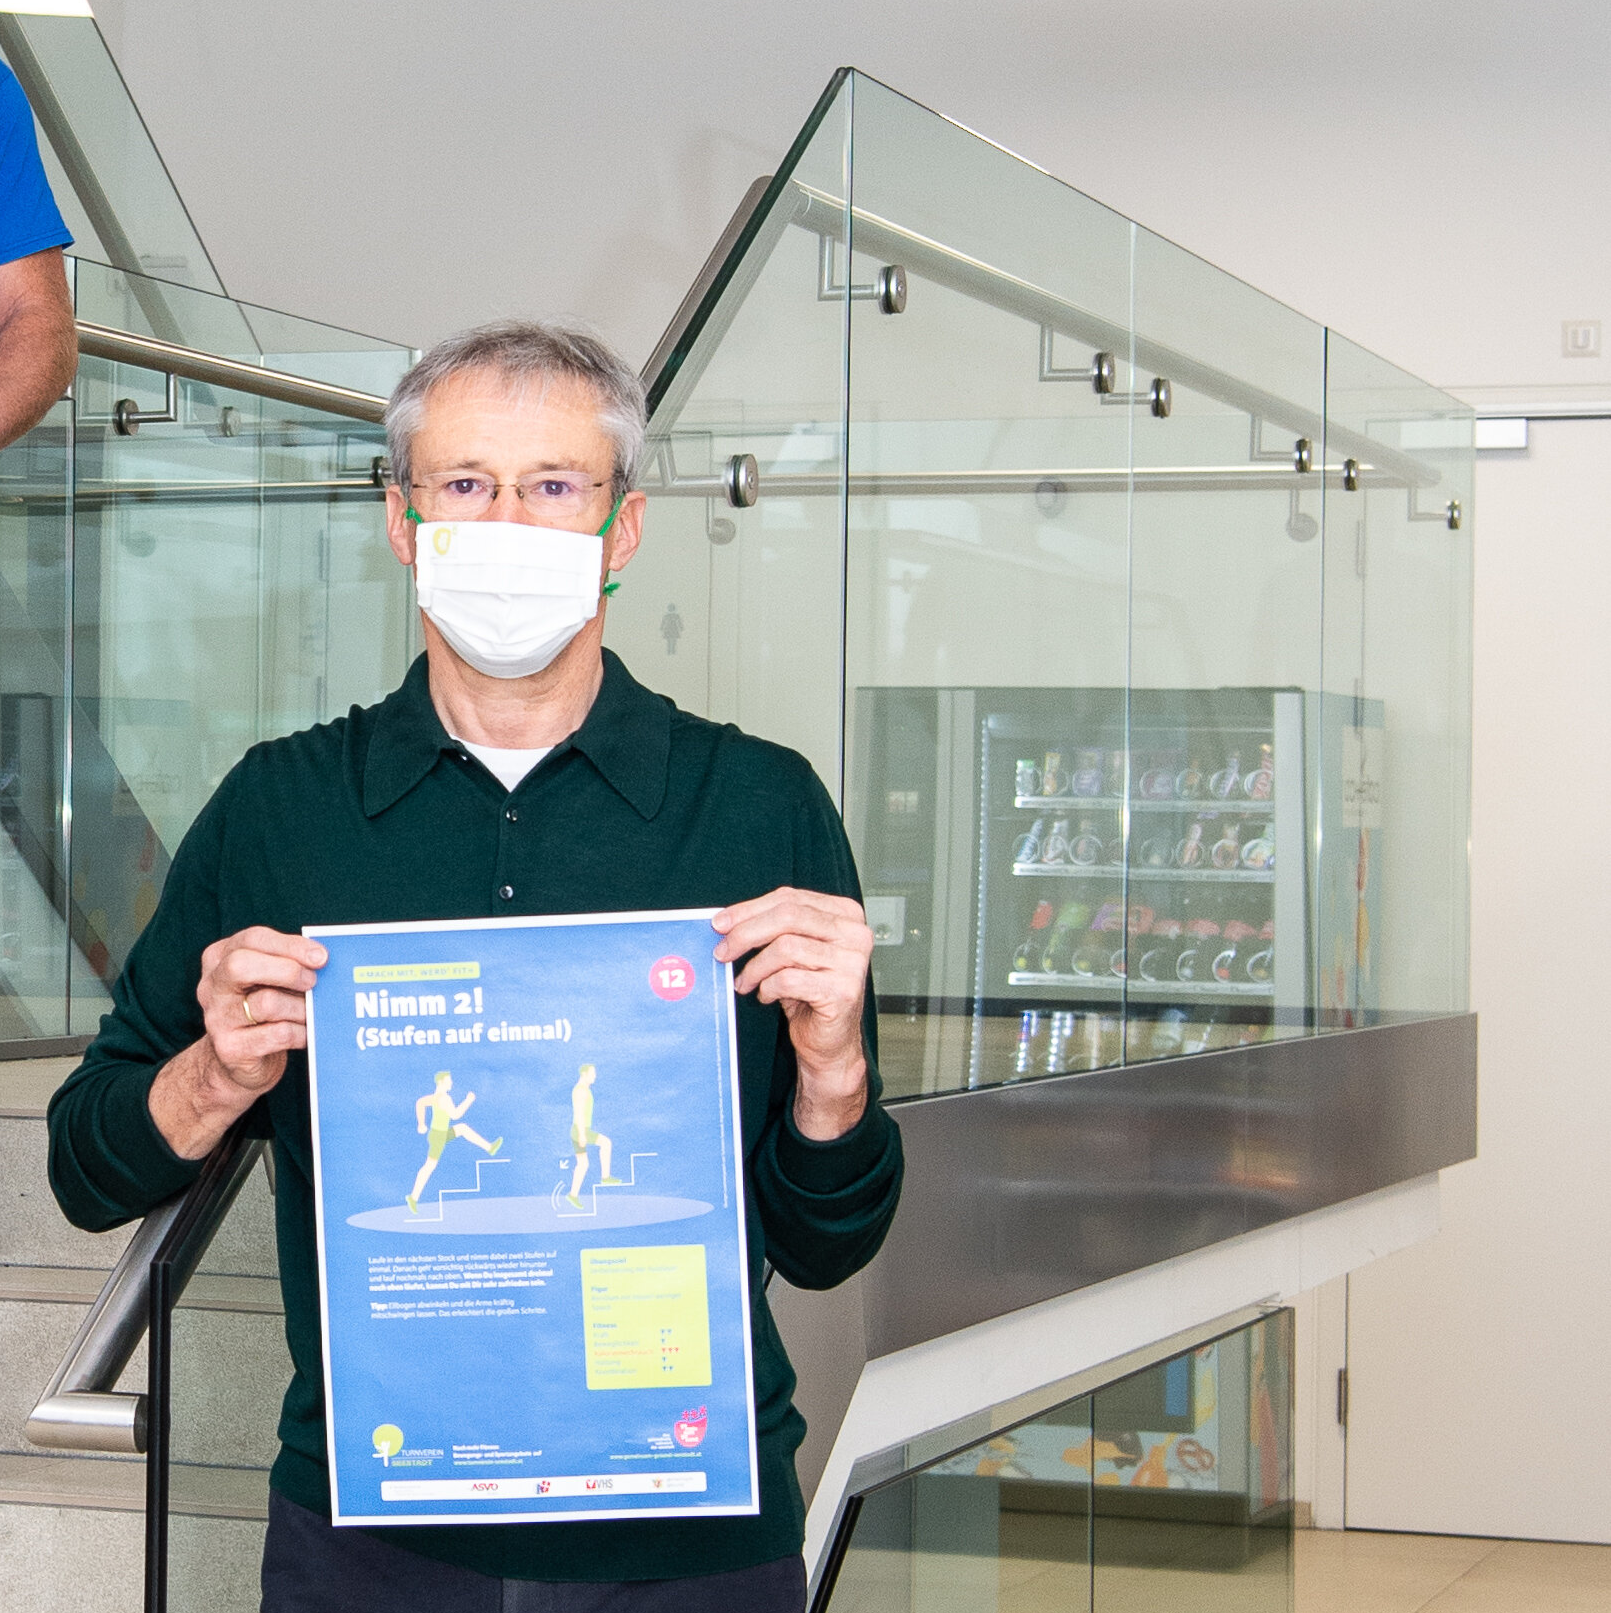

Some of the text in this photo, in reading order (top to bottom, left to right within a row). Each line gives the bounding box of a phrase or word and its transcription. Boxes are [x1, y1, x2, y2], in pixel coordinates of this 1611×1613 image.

[658, 969, 687, 989] 12
[354, 986, 484, 1019] Nimm 2!
[356, 1018, 573, 1051] (Stufen auf einmal)
